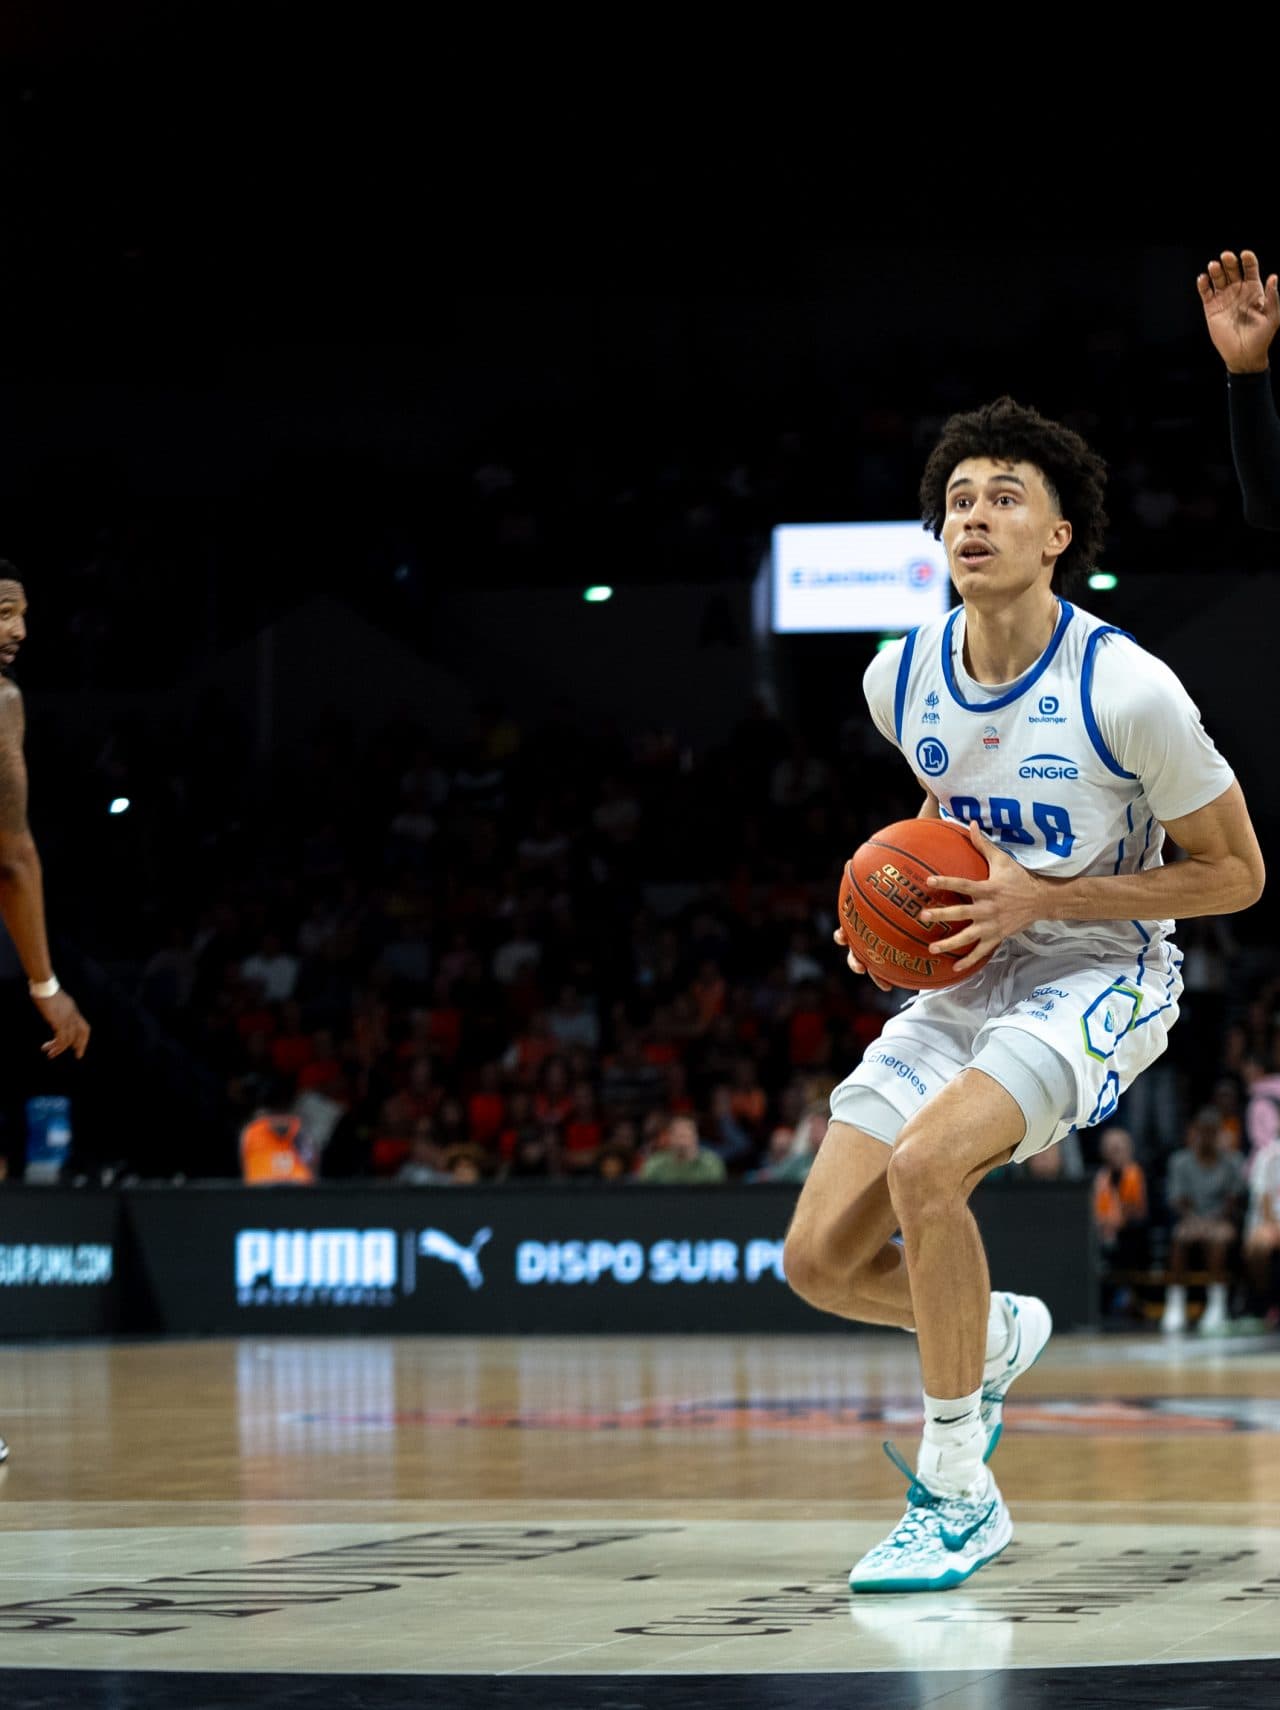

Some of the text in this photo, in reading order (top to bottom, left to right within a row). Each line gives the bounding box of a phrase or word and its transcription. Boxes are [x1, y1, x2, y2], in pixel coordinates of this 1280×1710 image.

[1028, 715, 1067, 725] boulanger
[842, 889, 941, 977] SPALDING
[236, 1229, 397, 1287] PUMA
[516, 1239, 644, 1284] DISPO
[650, 1239, 739, 1284] SUR
